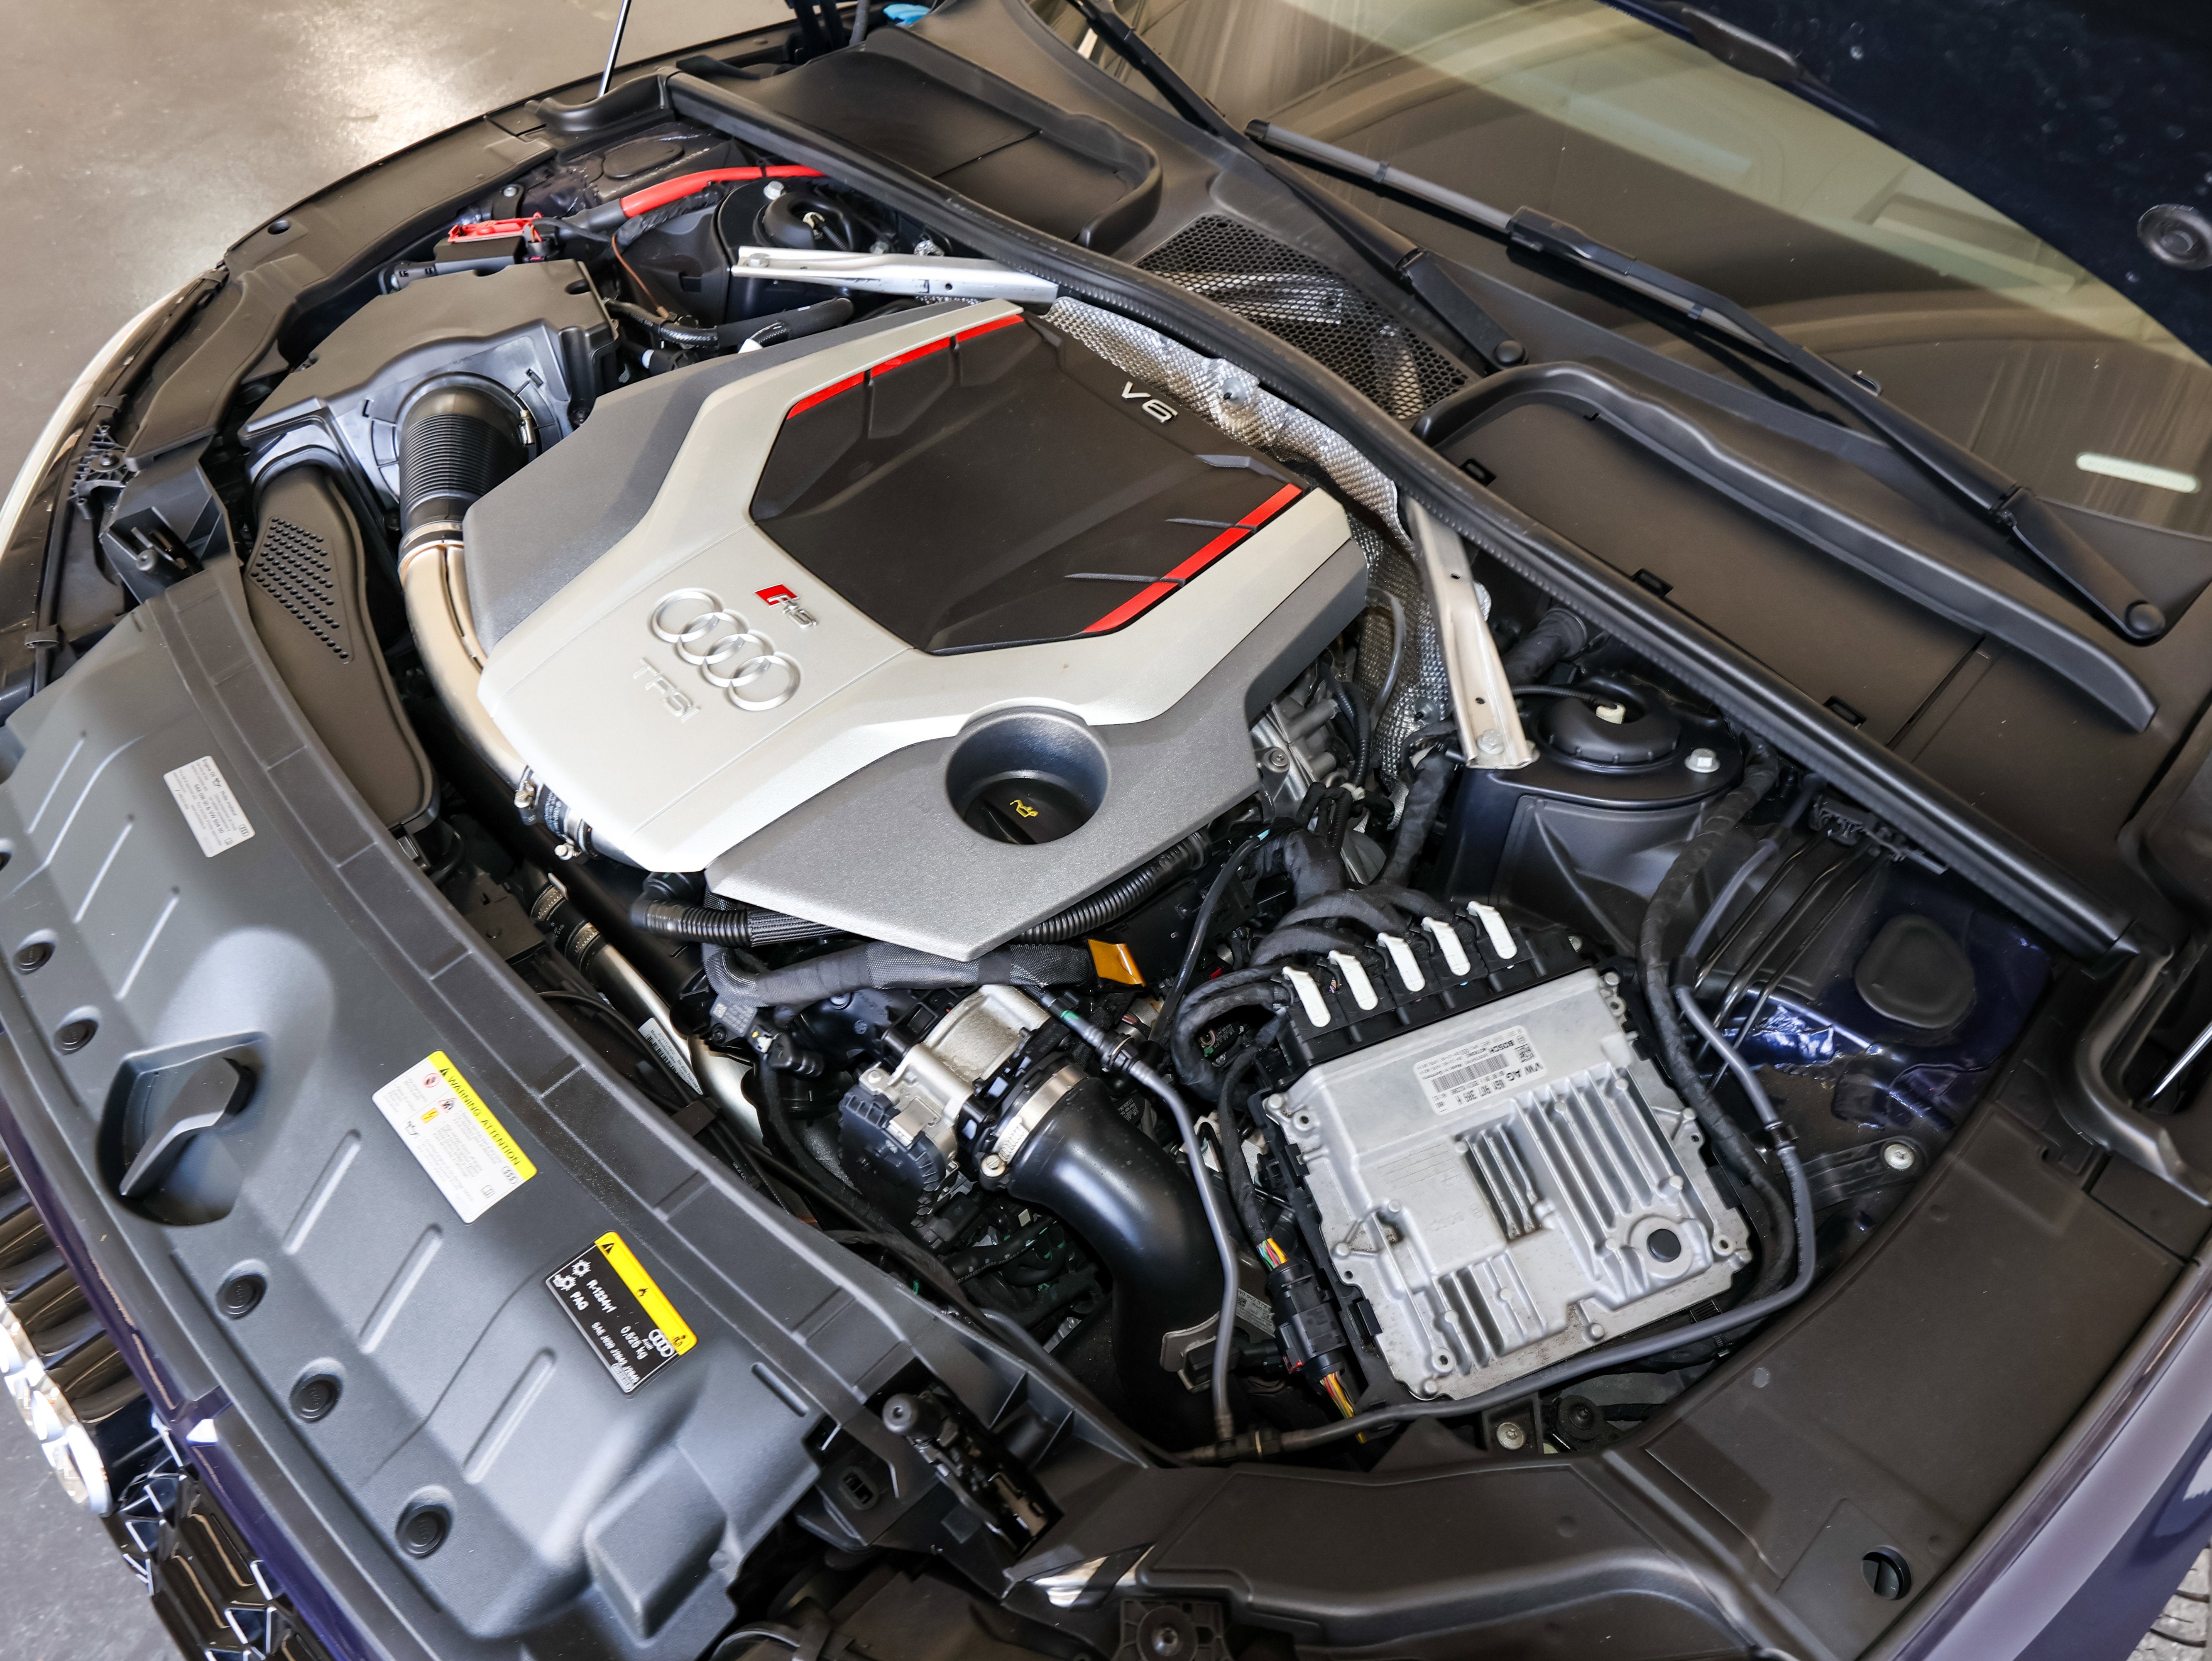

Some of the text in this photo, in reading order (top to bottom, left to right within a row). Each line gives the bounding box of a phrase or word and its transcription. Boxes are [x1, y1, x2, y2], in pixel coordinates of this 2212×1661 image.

[1121, 381, 1178, 423] V6
[767, 593, 819, 630] RS
[632, 657, 700, 723] TFSI
[1488, 1040, 1514, 1054] BOSCH
[1422, 1070, 1443, 1081] Germany
[1505, 1061, 1543, 1082] VW AG
[1462, 1090, 1477, 1102] 309
[1477, 1085, 1491, 1097] 907
[447, 1075, 482, 1117] WARNING
[480, 1117, 521, 1166] ATTENTION
[570, 1290, 589, 1311] PAG
[585, 1278, 617, 1315] R-1234yf
[634, 1345, 649, 1360] kg
[591, 1320, 606, 1336] SAE
[641, 1337, 654, 1351] Audi
